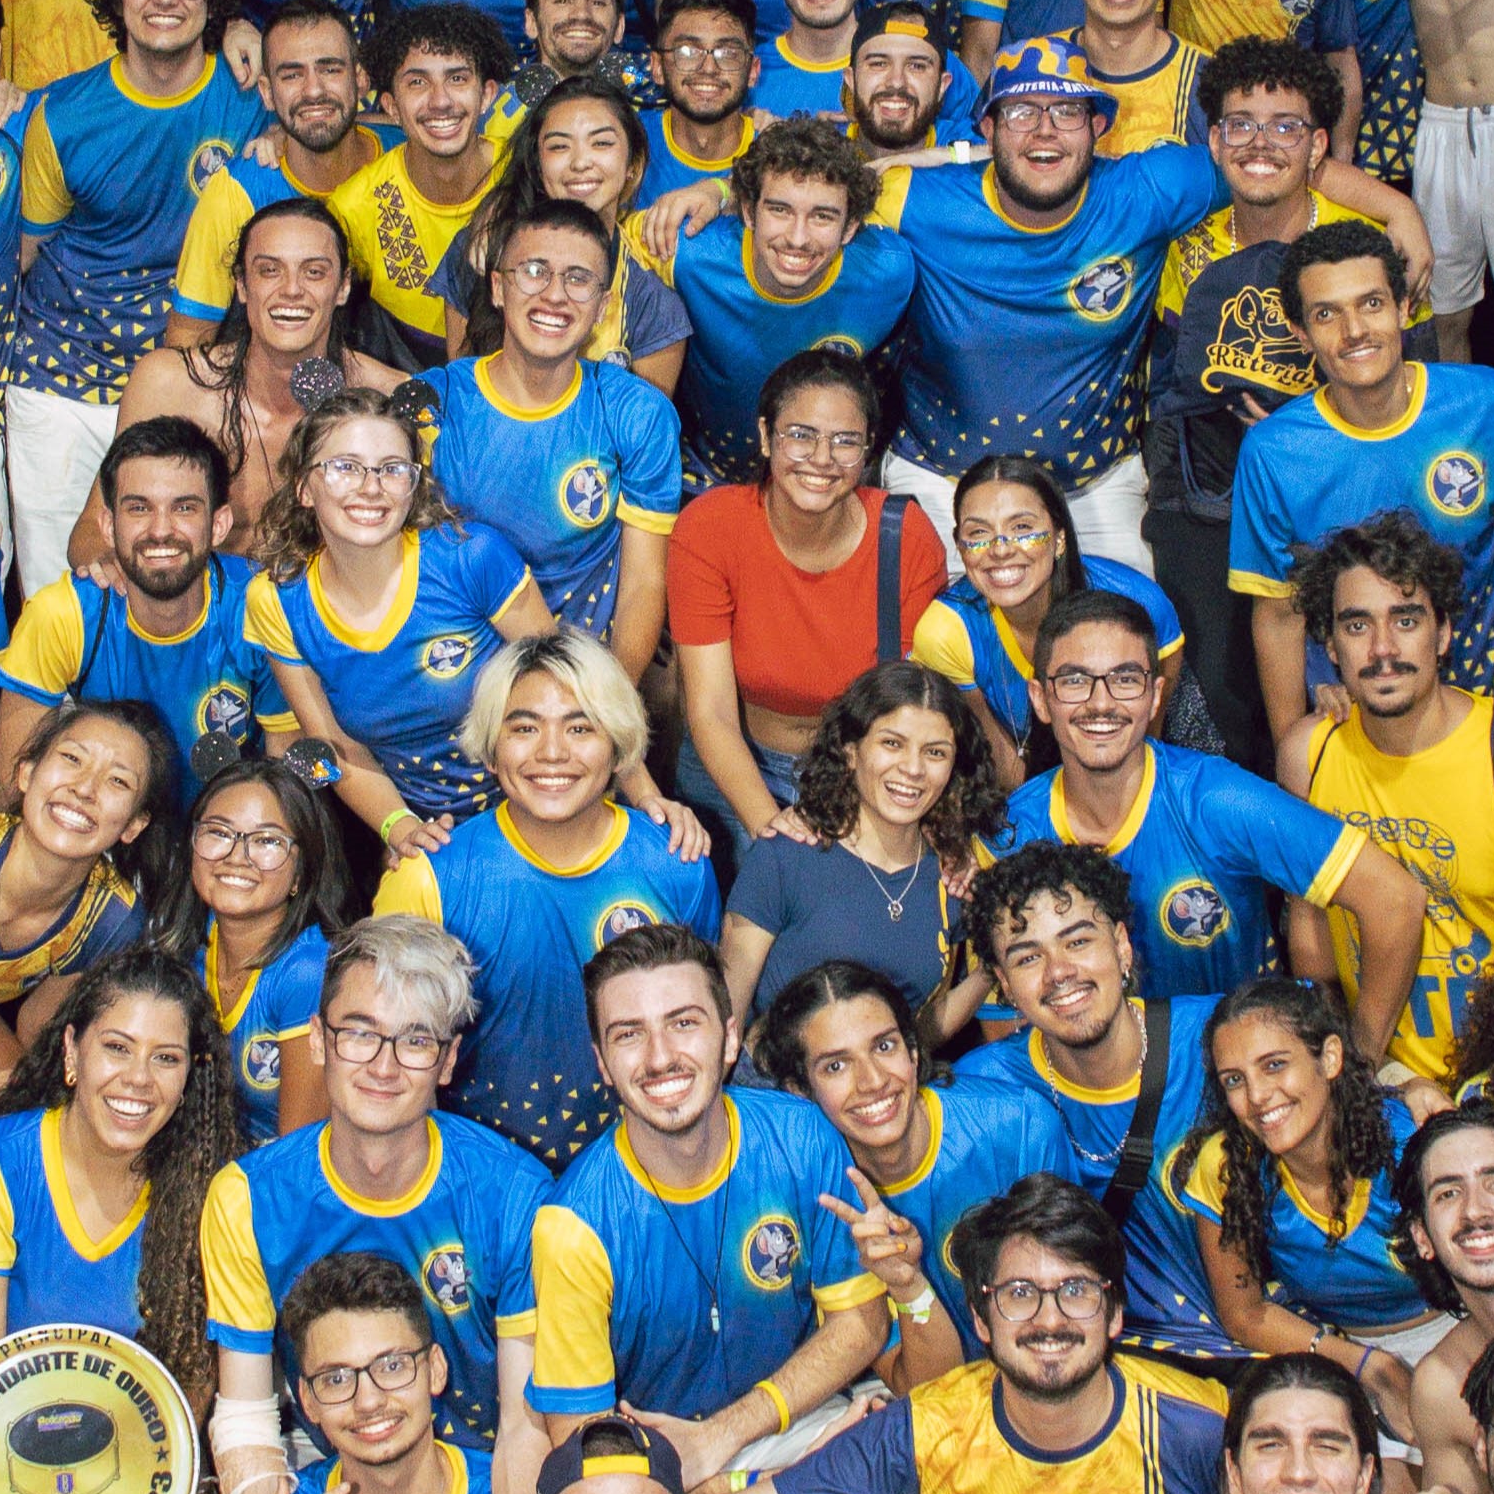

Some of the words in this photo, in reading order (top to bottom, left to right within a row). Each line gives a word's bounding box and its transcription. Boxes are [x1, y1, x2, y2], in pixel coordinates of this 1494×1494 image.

[1207, 344, 1316, 386] Rateria
[0, 1327, 113, 1358] PRINCIPAL
[82, 1353, 117, 1380] DE
[116, 1370, 168, 1445] OURO
